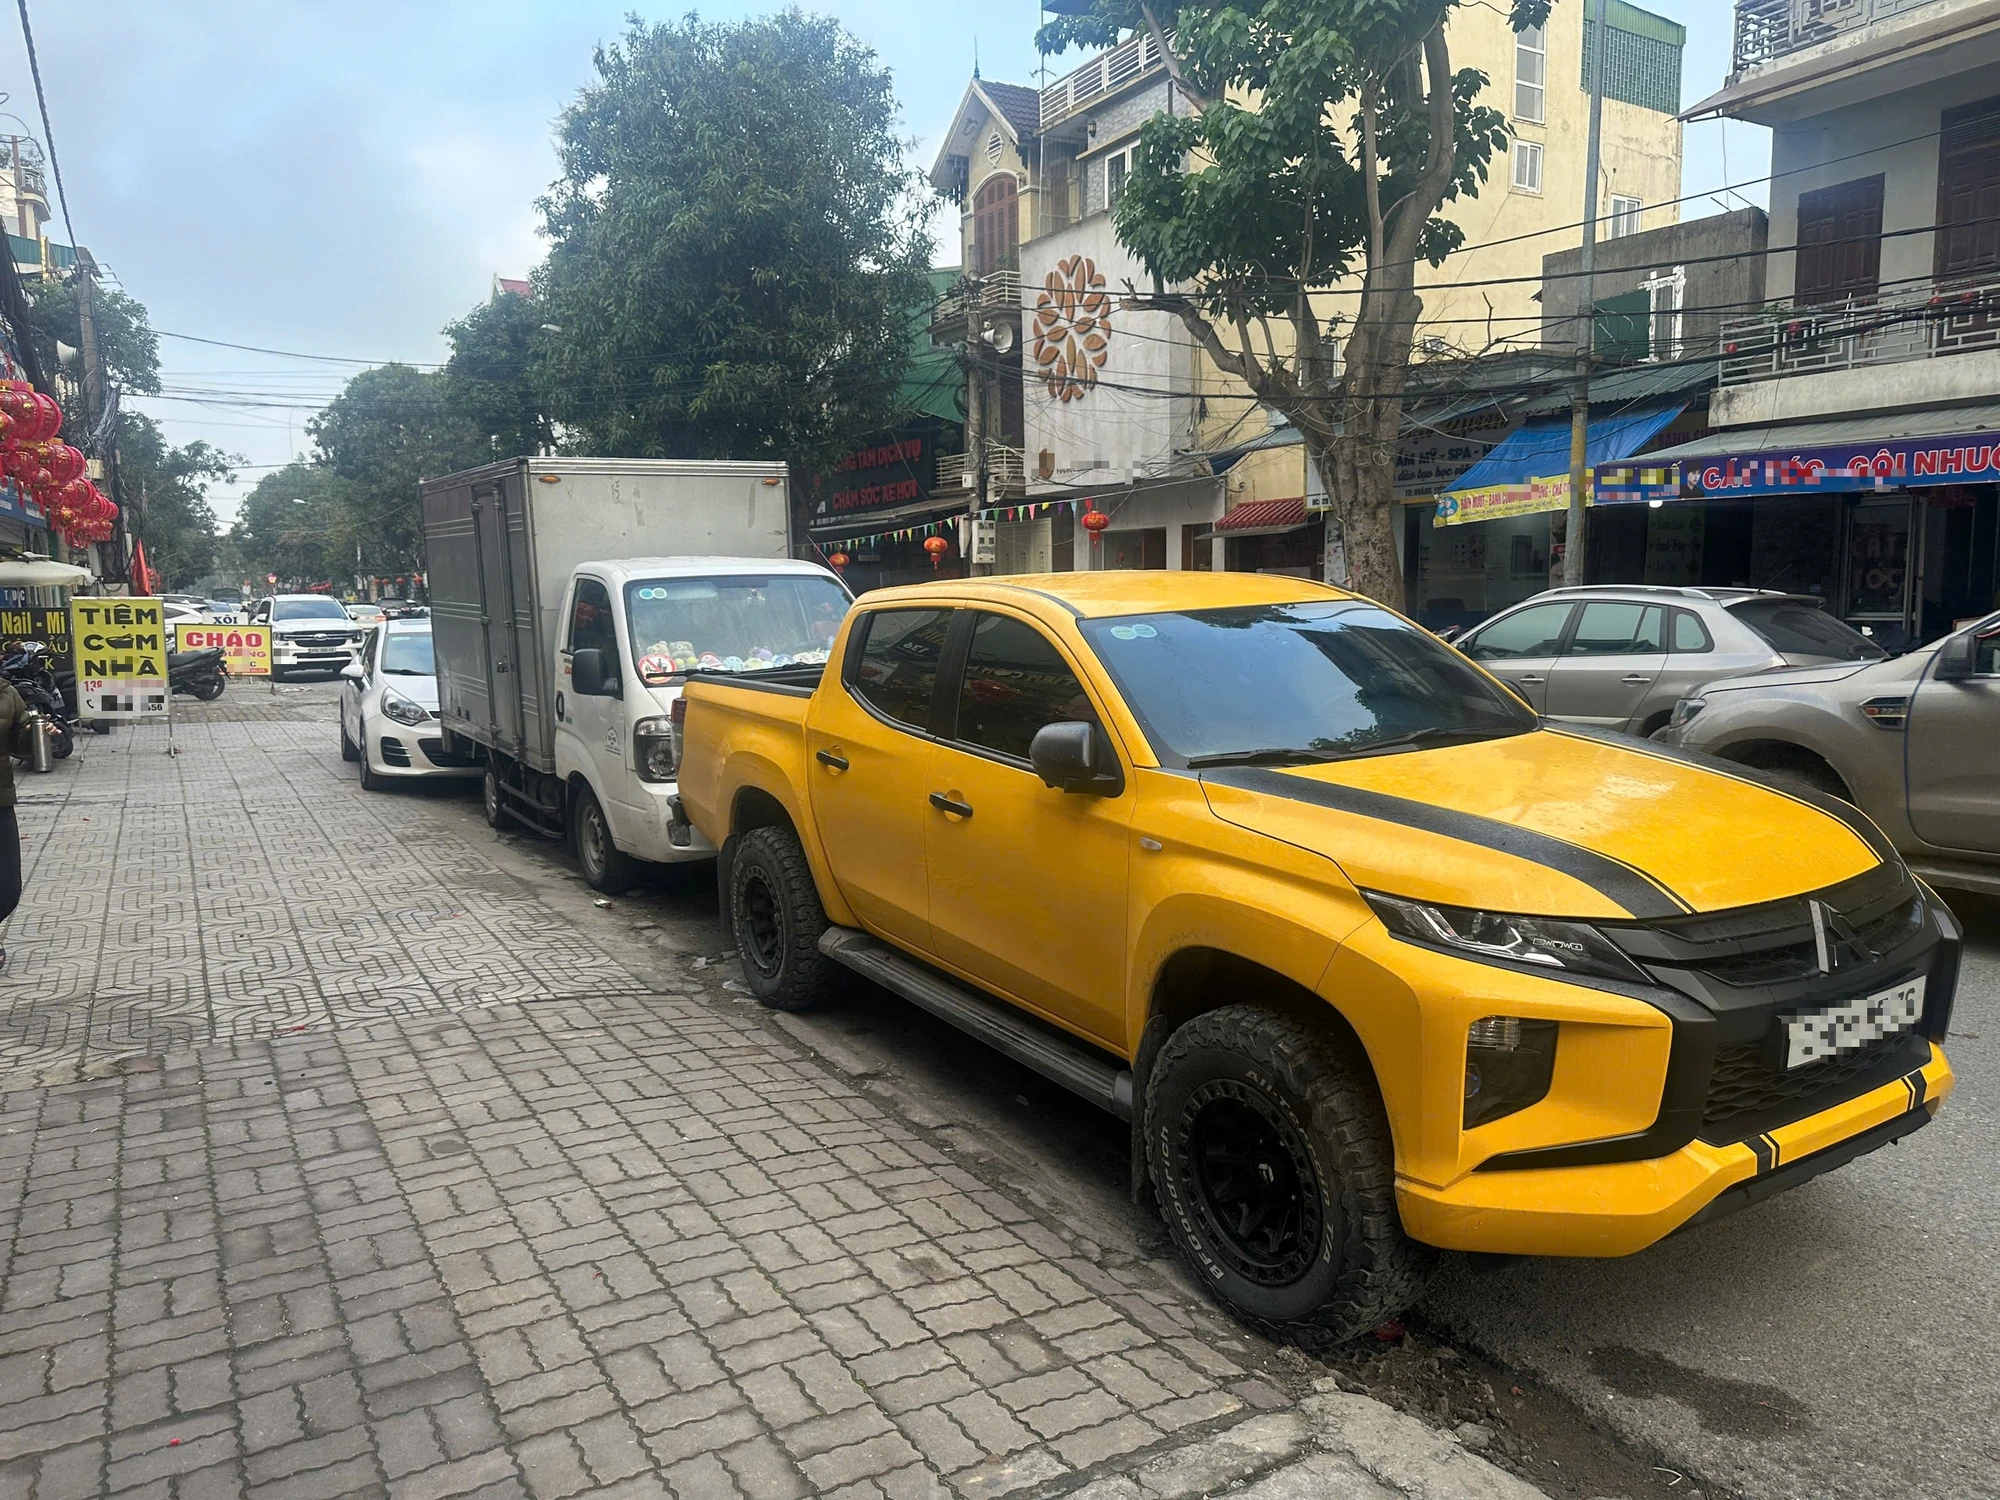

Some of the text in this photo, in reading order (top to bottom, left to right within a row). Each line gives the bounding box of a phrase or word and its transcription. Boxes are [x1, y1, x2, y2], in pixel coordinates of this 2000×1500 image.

[1447, 446, 1472, 460] SPA
[1, 611, 32, 635] Nail
[46, 611, 66, 635] Mi
[79, 603, 157, 629] TIỆM
[212, 614, 238, 624] XÔI
[186, 629, 263, 647] CHÁO
[1159, 1125, 1225, 1280] BFGoodrich
